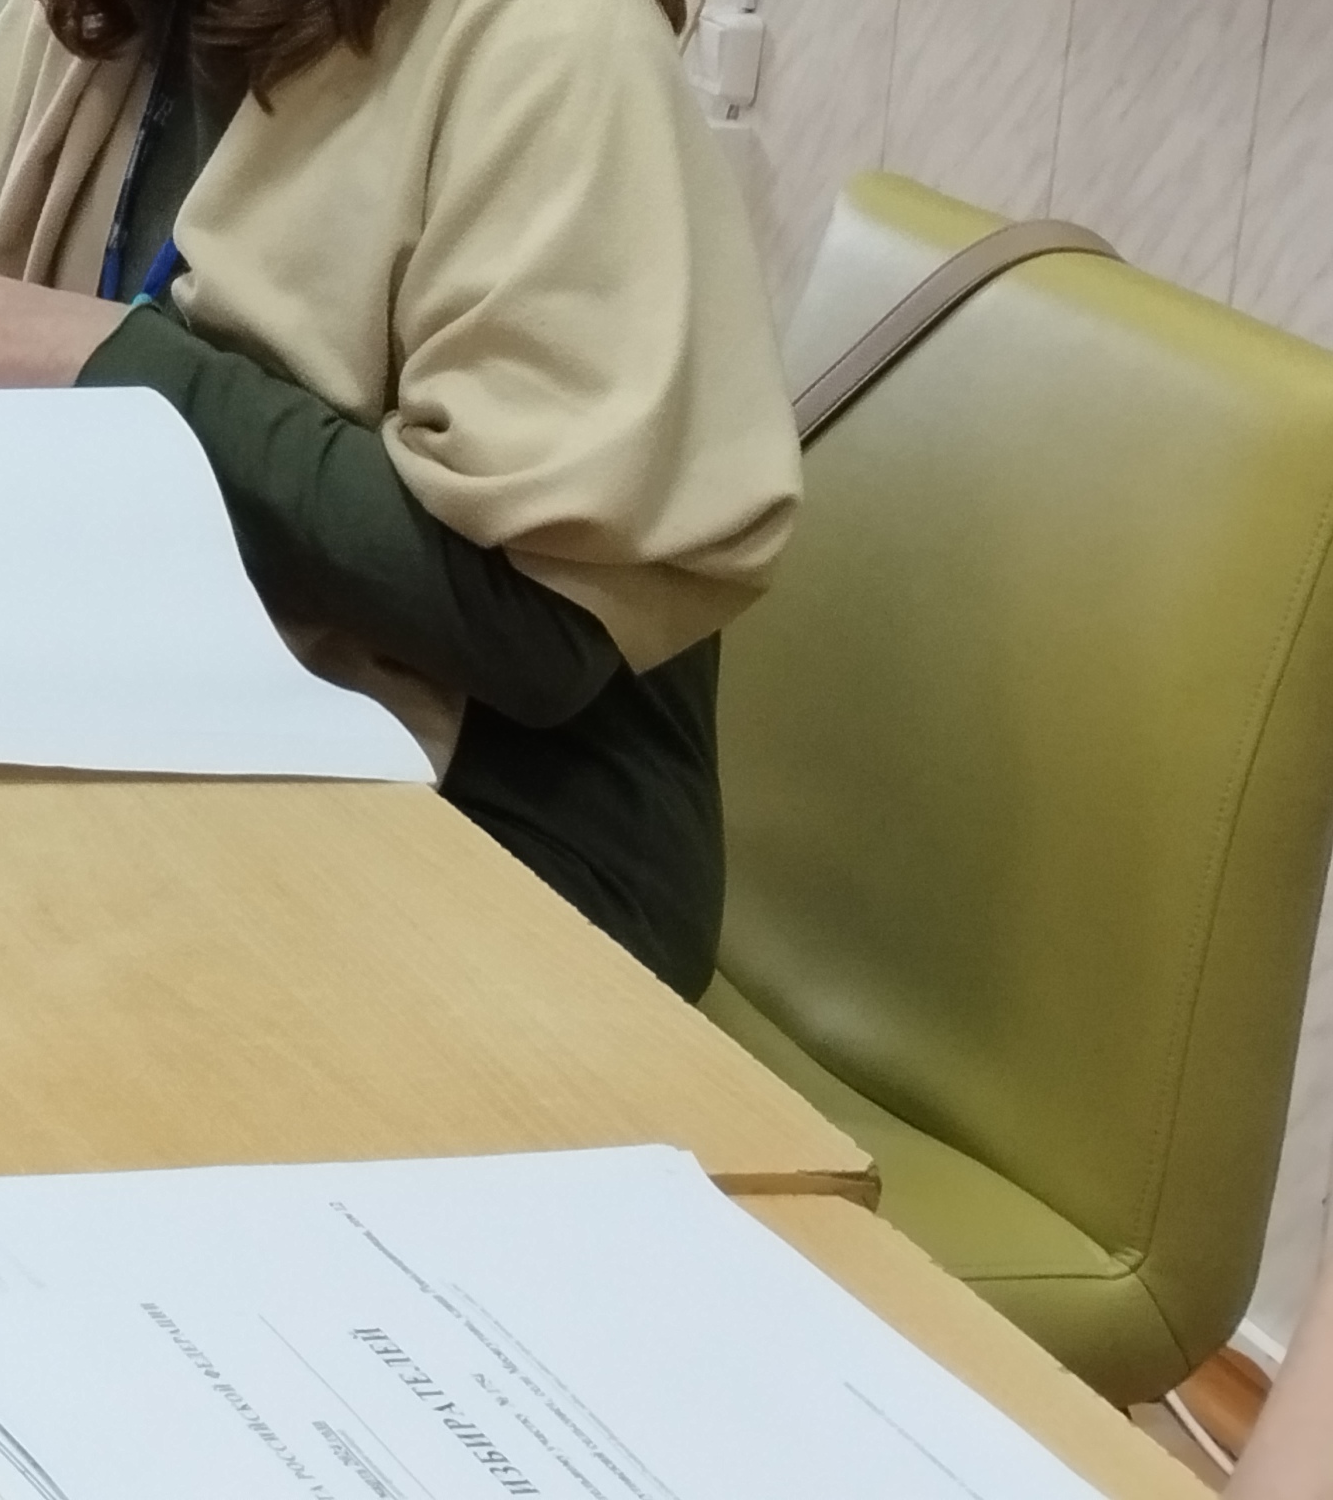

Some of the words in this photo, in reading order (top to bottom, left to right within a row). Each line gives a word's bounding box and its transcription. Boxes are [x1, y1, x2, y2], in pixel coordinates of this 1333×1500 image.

[141, 1302, 221, 1379] ФЕДЕРАЦИИ
[211, 1383, 315, 1481] РОССИЙСКОЙ
[347, 1326, 540, 1495] ИЗБИРАТЕЛЕЙ
